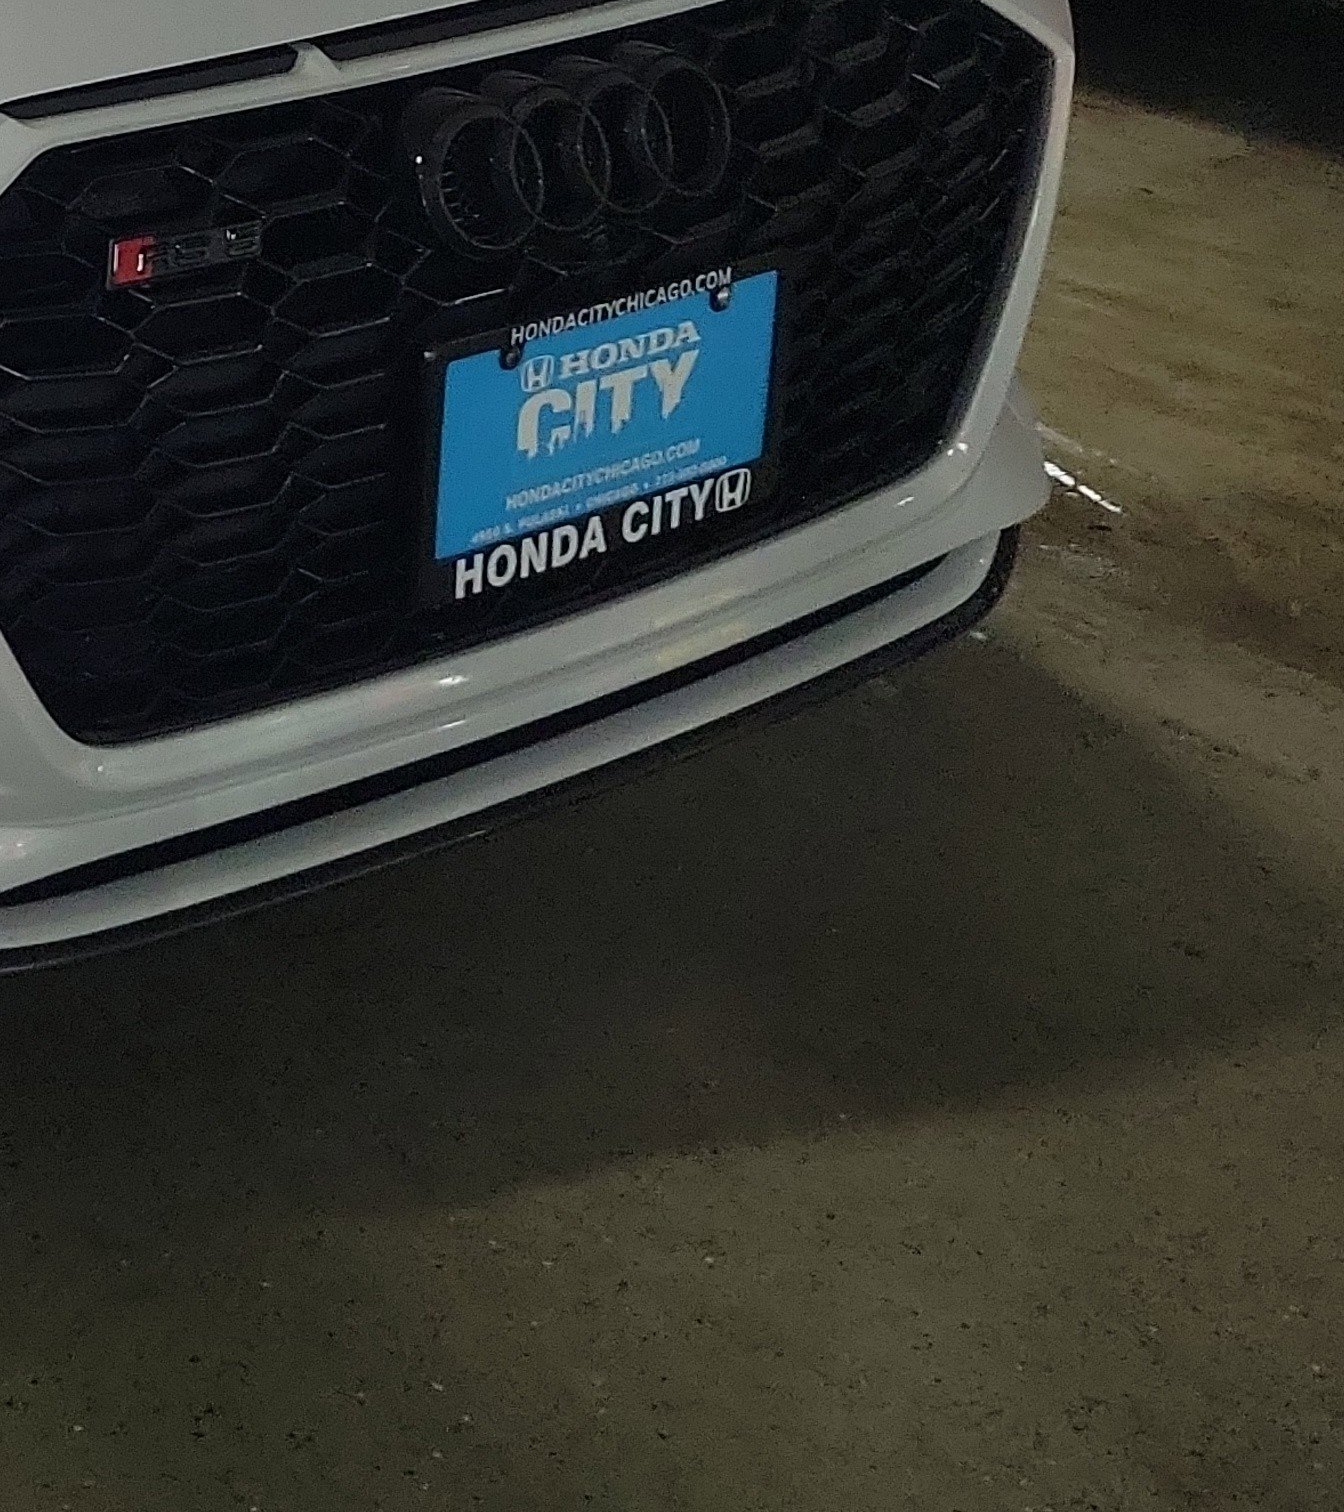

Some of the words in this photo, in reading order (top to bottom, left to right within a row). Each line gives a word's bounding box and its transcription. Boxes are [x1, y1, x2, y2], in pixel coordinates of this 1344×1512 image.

[510, 266, 732, 345] HONDACITYCHICAGO.COM
[558, 321, 702, 379] HONDA
[516, 349, 700, 459] CITY
[454, 516, 607, 600] HONDA
[621, 478, 715, 543] CITY
